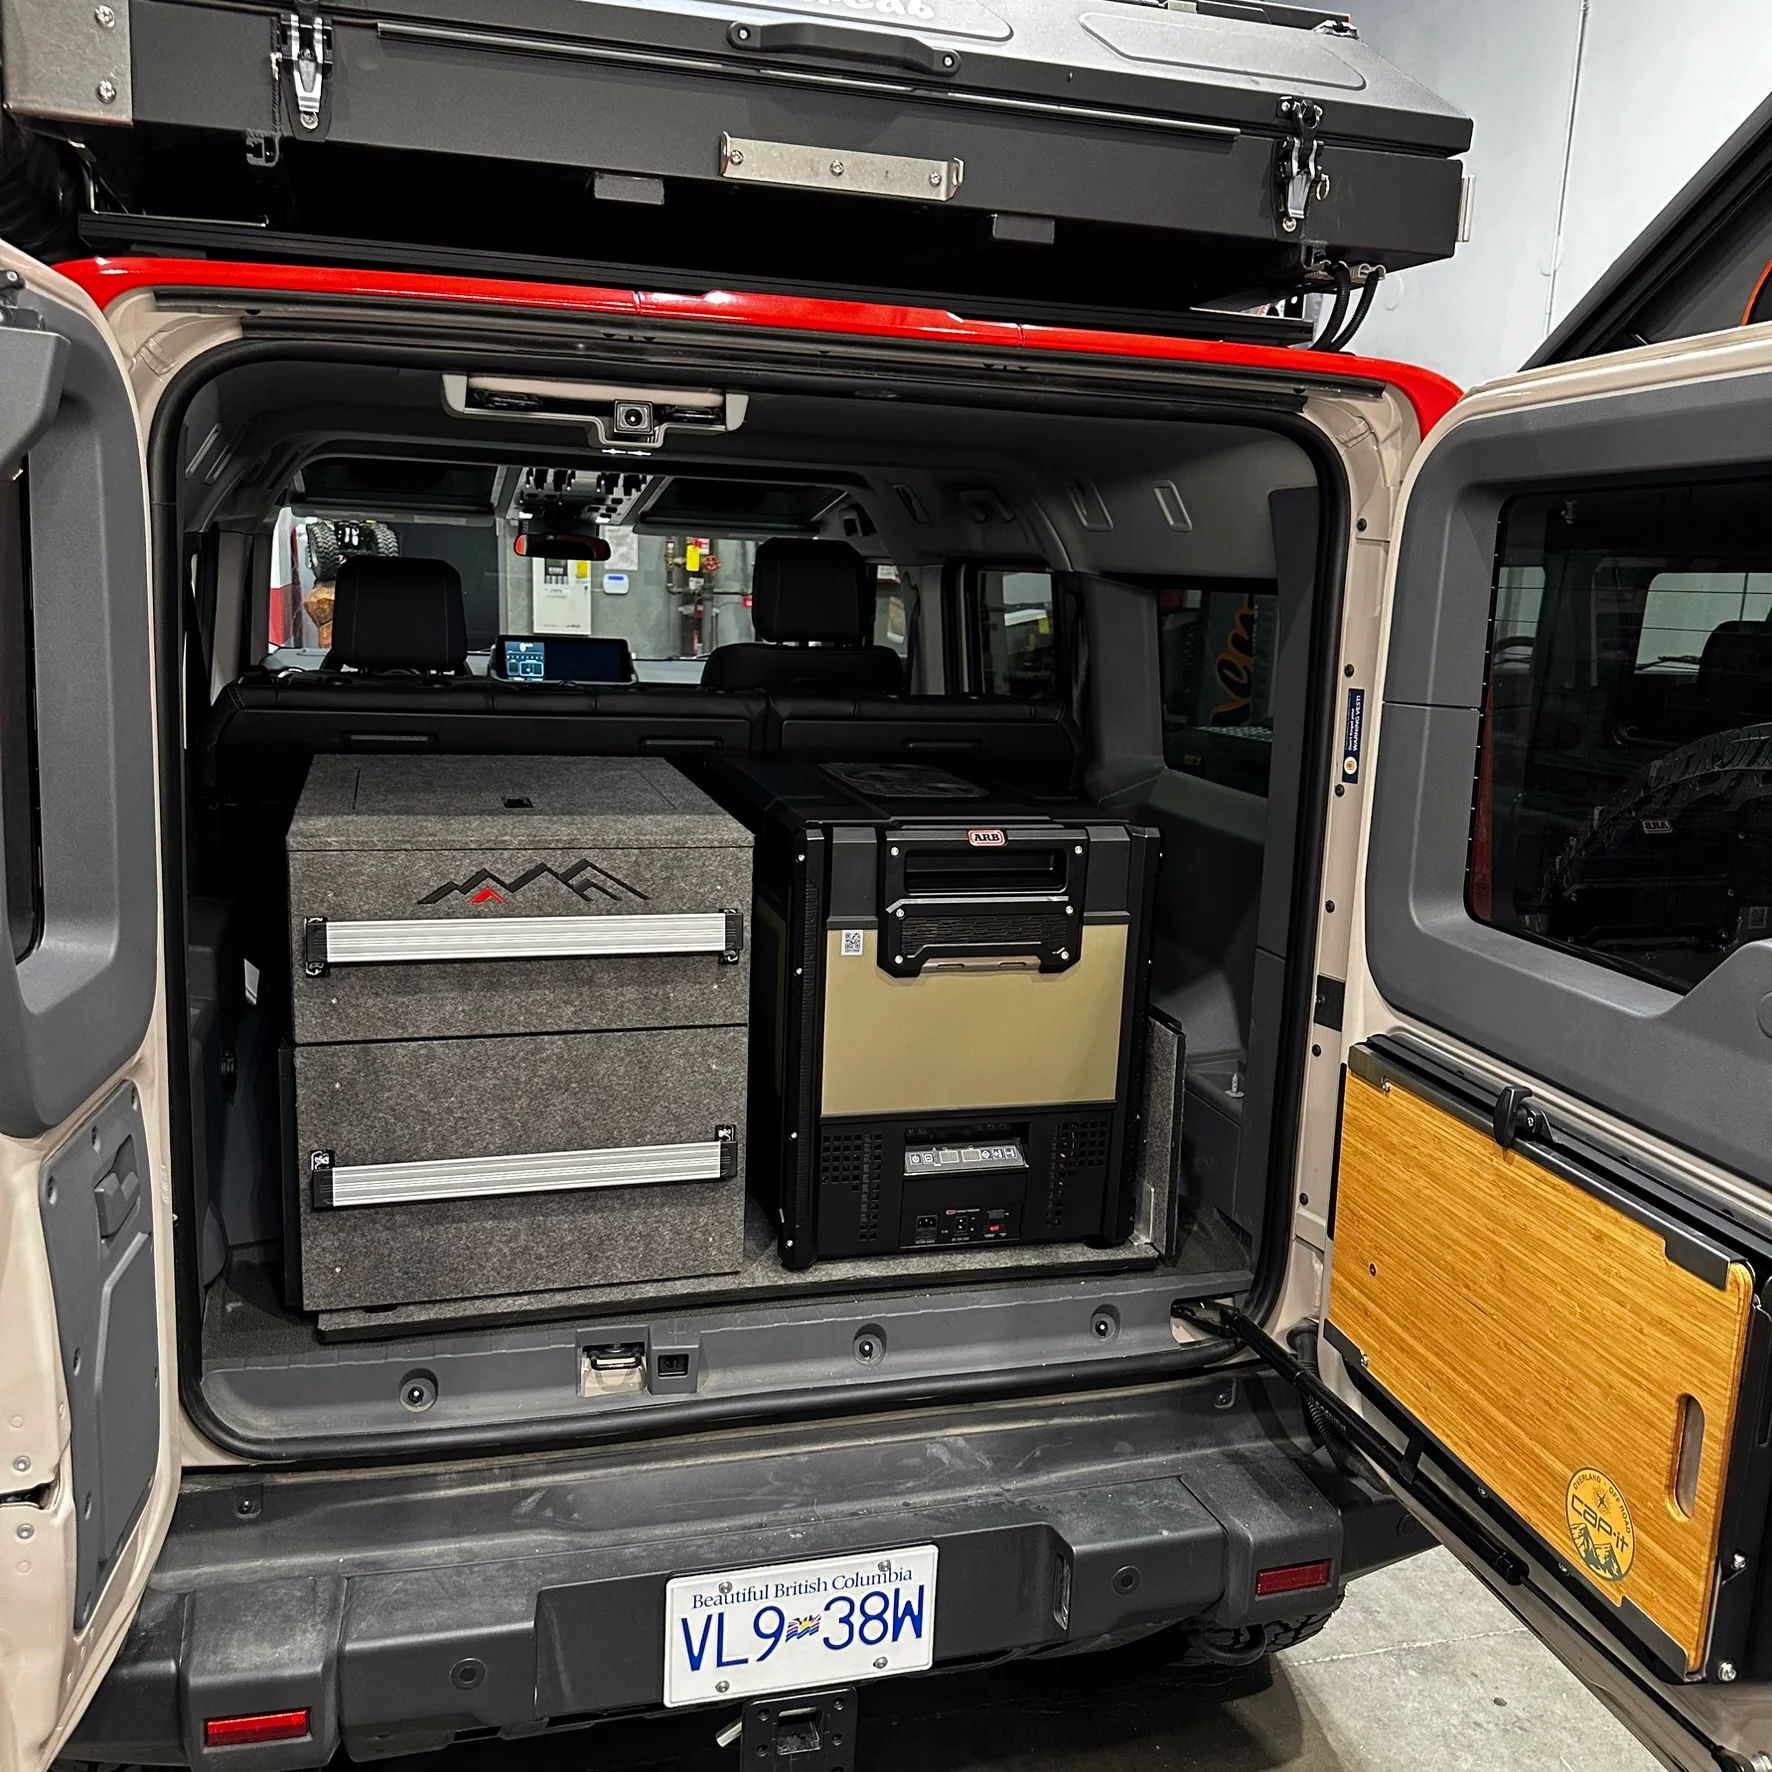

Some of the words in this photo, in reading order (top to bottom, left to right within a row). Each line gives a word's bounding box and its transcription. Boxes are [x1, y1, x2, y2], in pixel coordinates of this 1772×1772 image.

[974, 833, 1000, 842] ARB
[1573, 1474, 1601, 1490] OVERLAND
[1609, 1486, 1621, 1502] OFF
[1619, 1505, 1631, 1533] ROAD
[692, 1584, 769, 1609] Beautiful
[774, 1578, 828, 1597] British
[832, 1567, 913, 1590] Columbia
